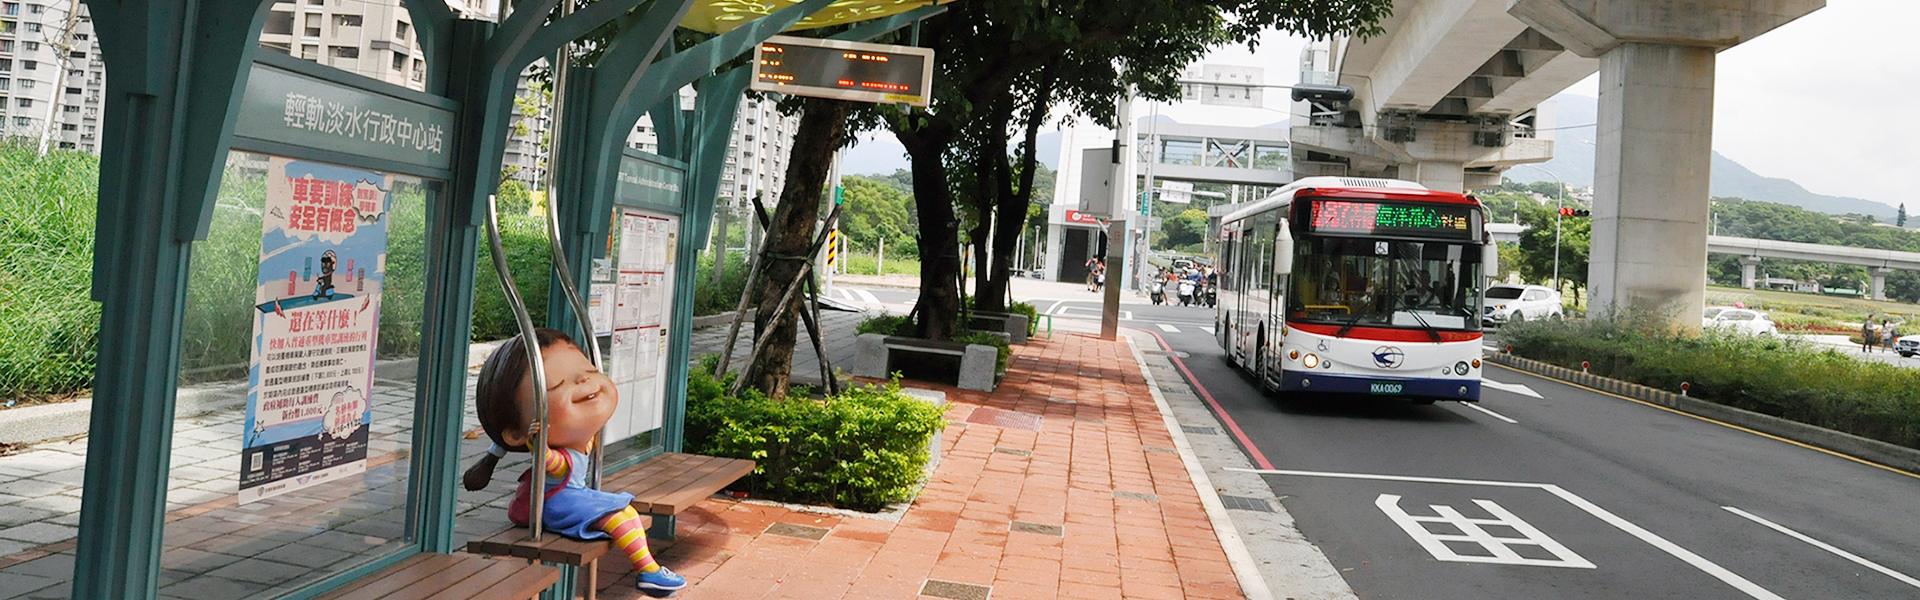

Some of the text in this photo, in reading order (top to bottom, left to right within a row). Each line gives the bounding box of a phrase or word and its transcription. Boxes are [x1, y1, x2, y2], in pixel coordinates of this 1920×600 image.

[284, 91, 443, 154] 輕軌淡水行政中心站
[288, 175, 353, 208] 車要訓練
[289, 204, 356, 233] 安全有概念
